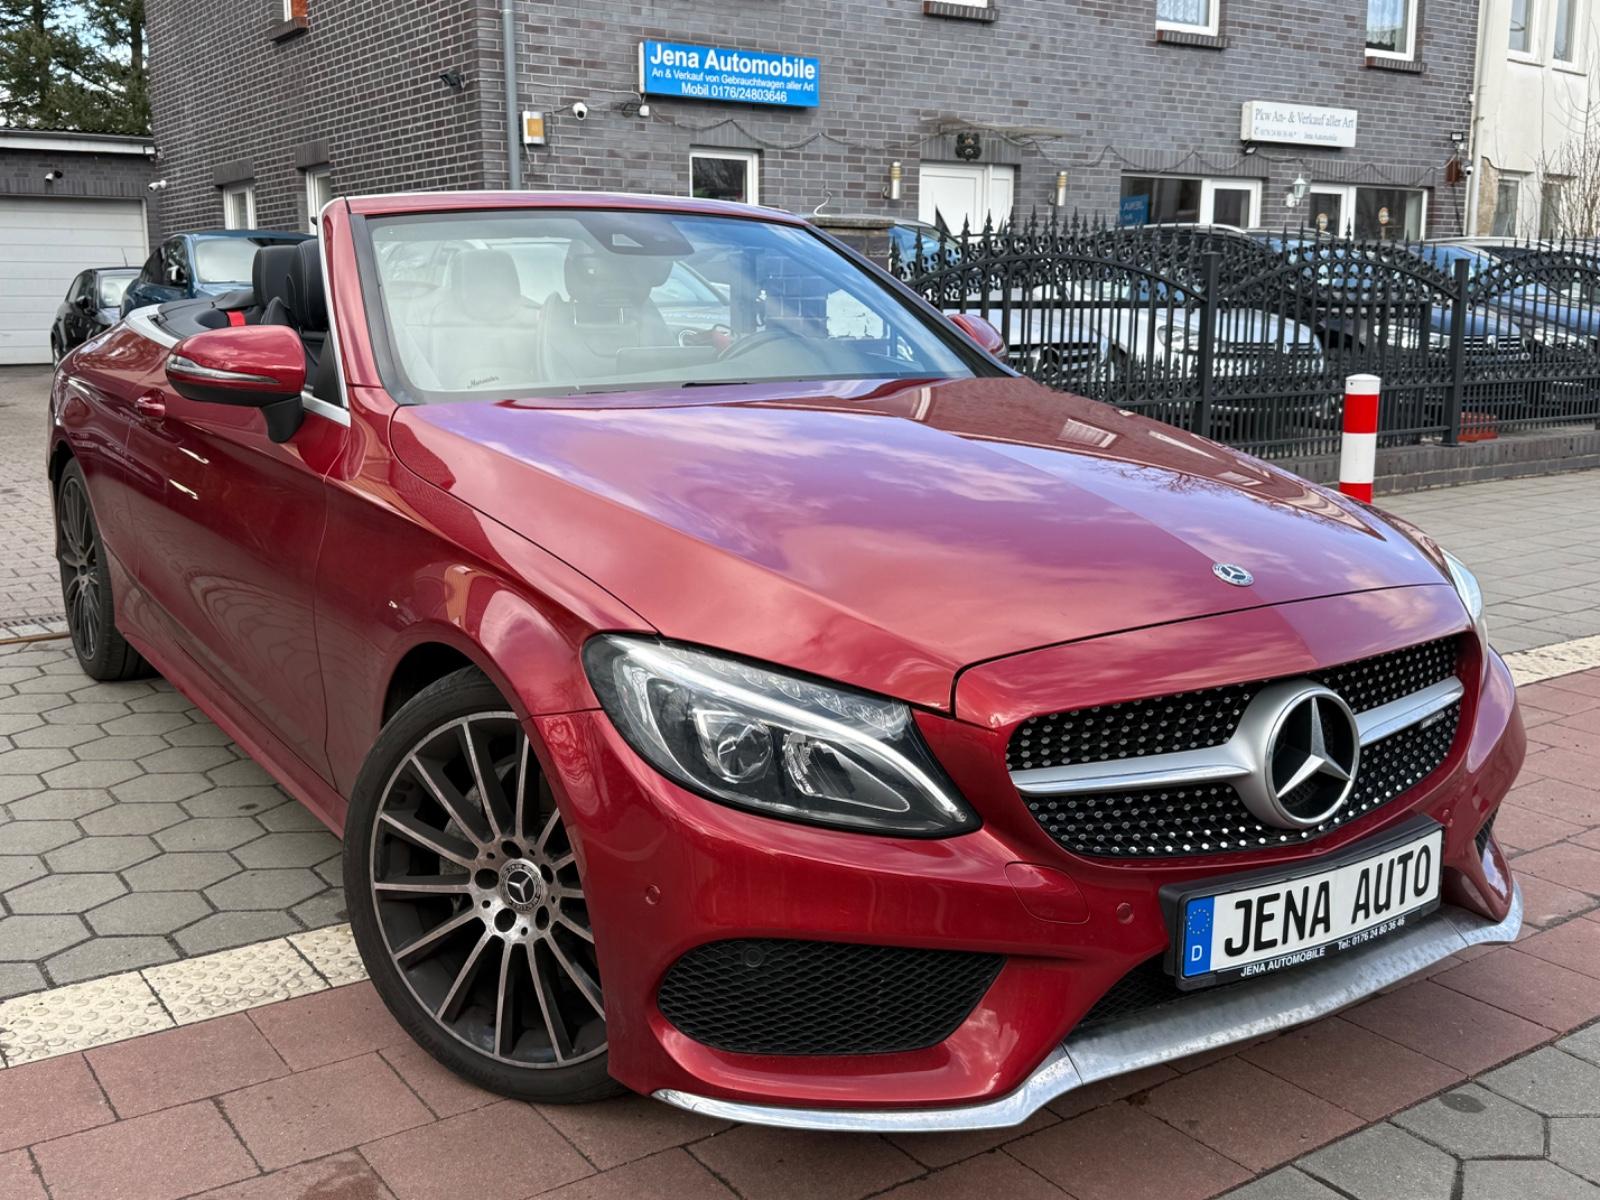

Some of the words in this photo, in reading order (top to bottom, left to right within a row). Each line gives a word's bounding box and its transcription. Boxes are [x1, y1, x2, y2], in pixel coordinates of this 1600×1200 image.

[650, 43, 699, 68] Jena
[704, 49, 816, 79] Automobile
[652, 67, 664, 78] An
[665, 69, 672, 78] &
[673, 70, 704, 82] Verkauf
[705, 75, 719, 83] von
[786, 80, 802, 91] aller
[803, 82, 815, 92] Art
[681, 81, 709, 96] Mobil
[711, 85, 788, 103] 0176/24803646
[1287, 112, 1295, 124] &
[1342, 117, 1355, 129] Art
[1223, 880, 1332, 957] JENA
[1351, 844, 1432, 925] AUTO
[1337, 939, 1351, 951] Tel:
[1352, 931, 1369, 947] 0176
[1369, 928, 1378, 939] 24
[1191, 945, 1203, 962] D
[1240, 963, 1266, 978] JENA
[1267, 947, 1326, 972] AUTOMOBILE
